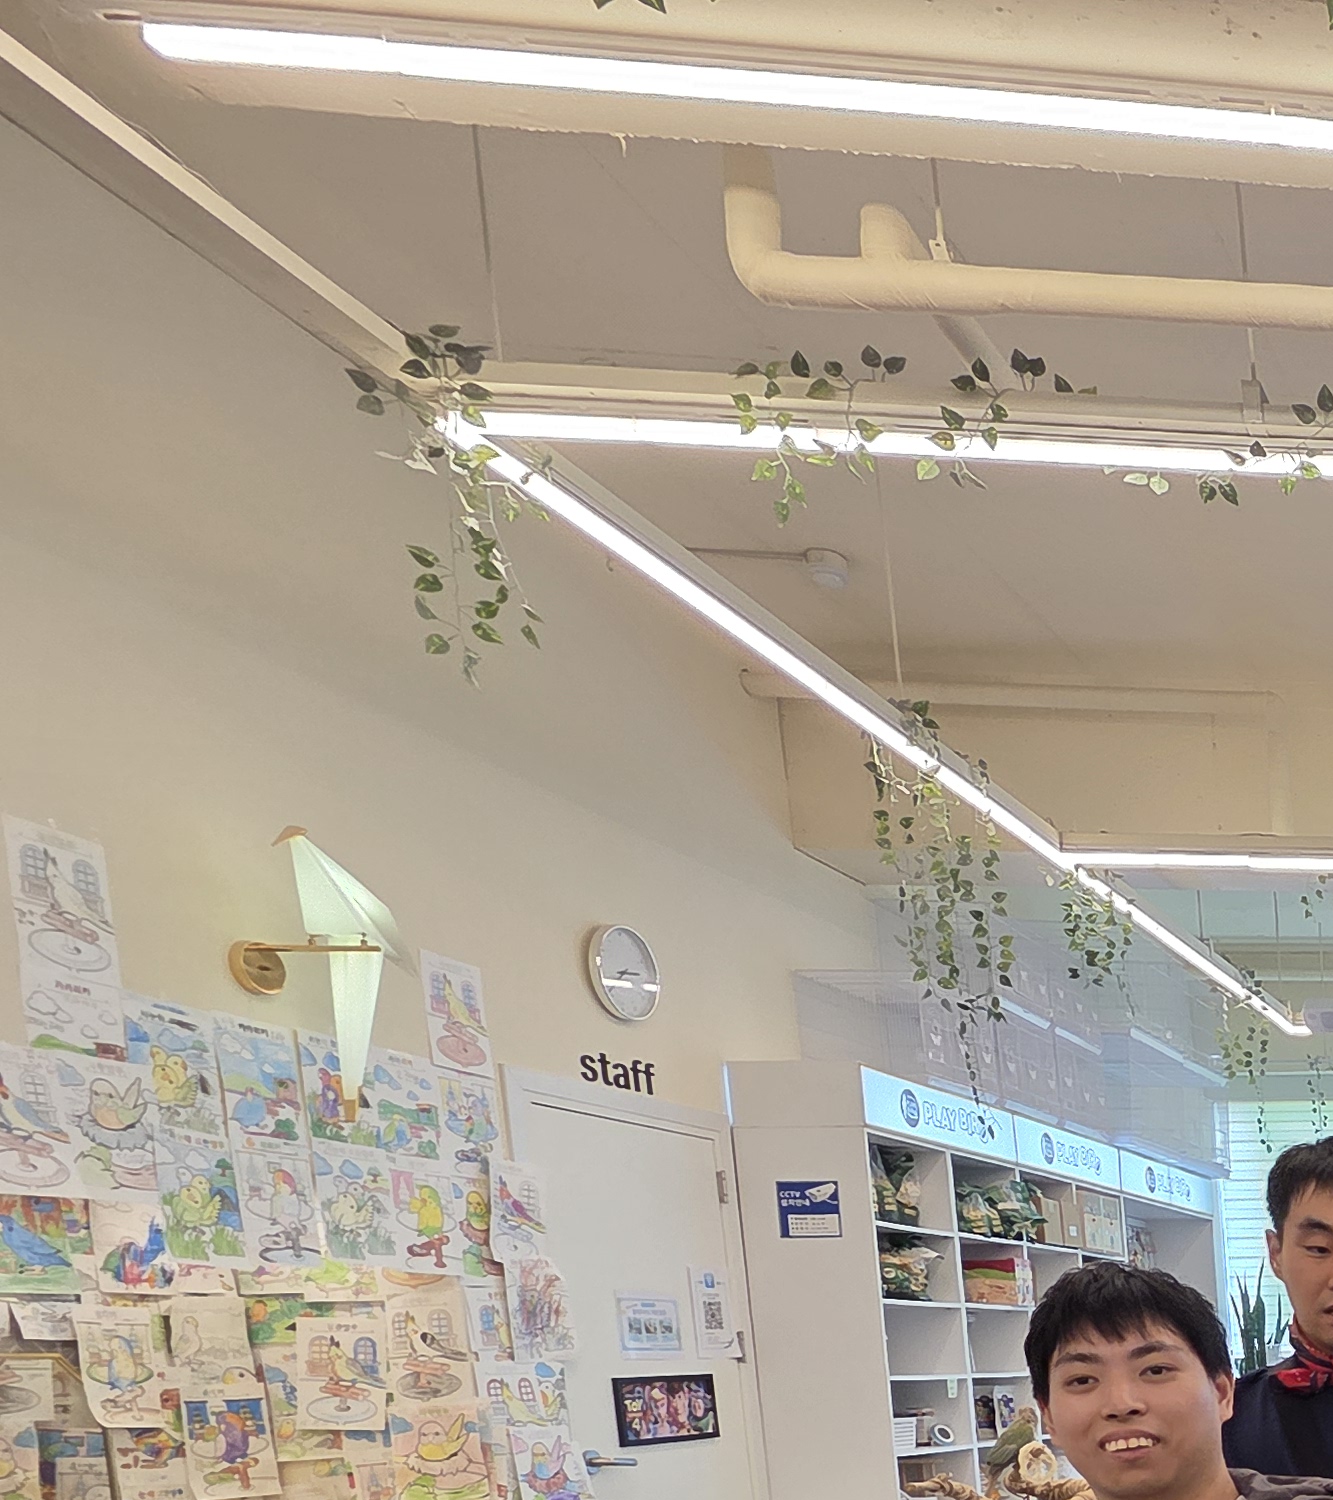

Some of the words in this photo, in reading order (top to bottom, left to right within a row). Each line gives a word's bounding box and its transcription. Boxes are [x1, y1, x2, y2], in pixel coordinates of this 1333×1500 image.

[579, 1052, 656, 1096] staff
[923, 1101, 956, 1131] PLAY
[779, 1190, 801, 1198] CCTV
